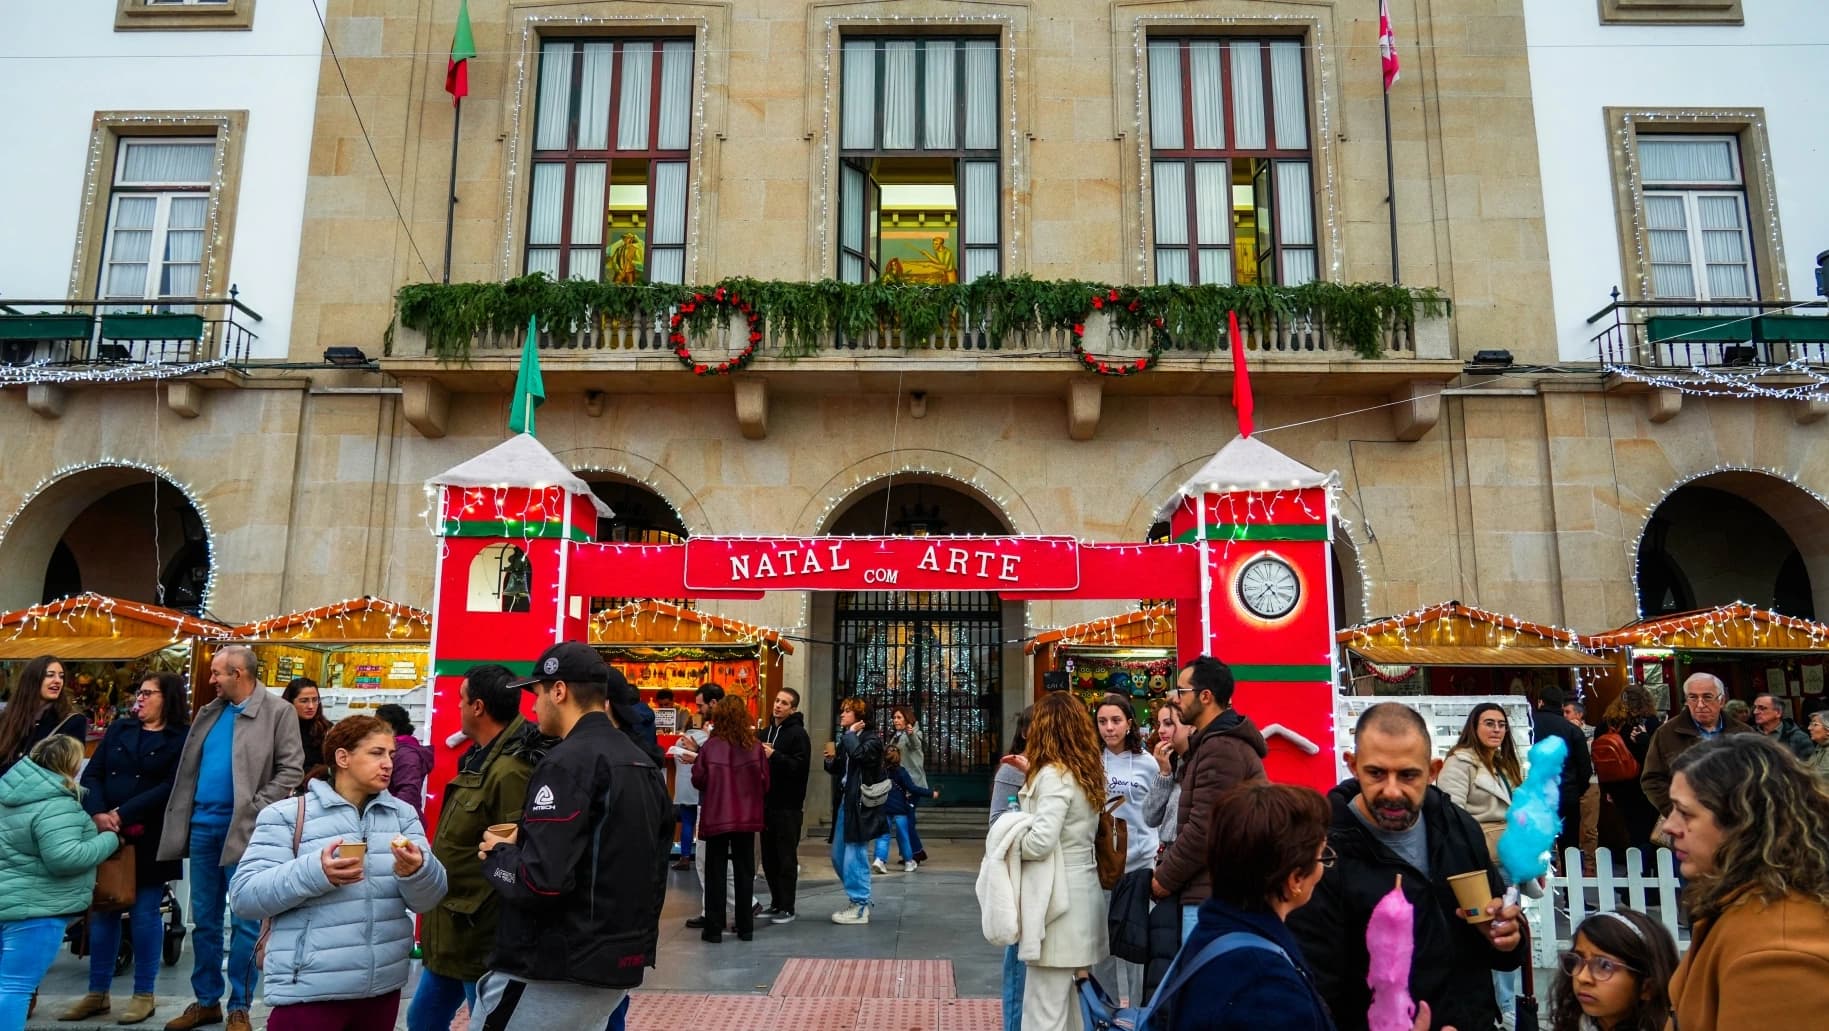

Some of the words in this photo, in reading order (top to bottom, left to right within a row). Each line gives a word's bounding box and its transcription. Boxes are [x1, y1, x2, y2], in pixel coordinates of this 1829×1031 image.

[730, 546, 850, 581] NATAL
[864, 567, 899, 584] COM
[917, 545, 1021, 582] ARTE
